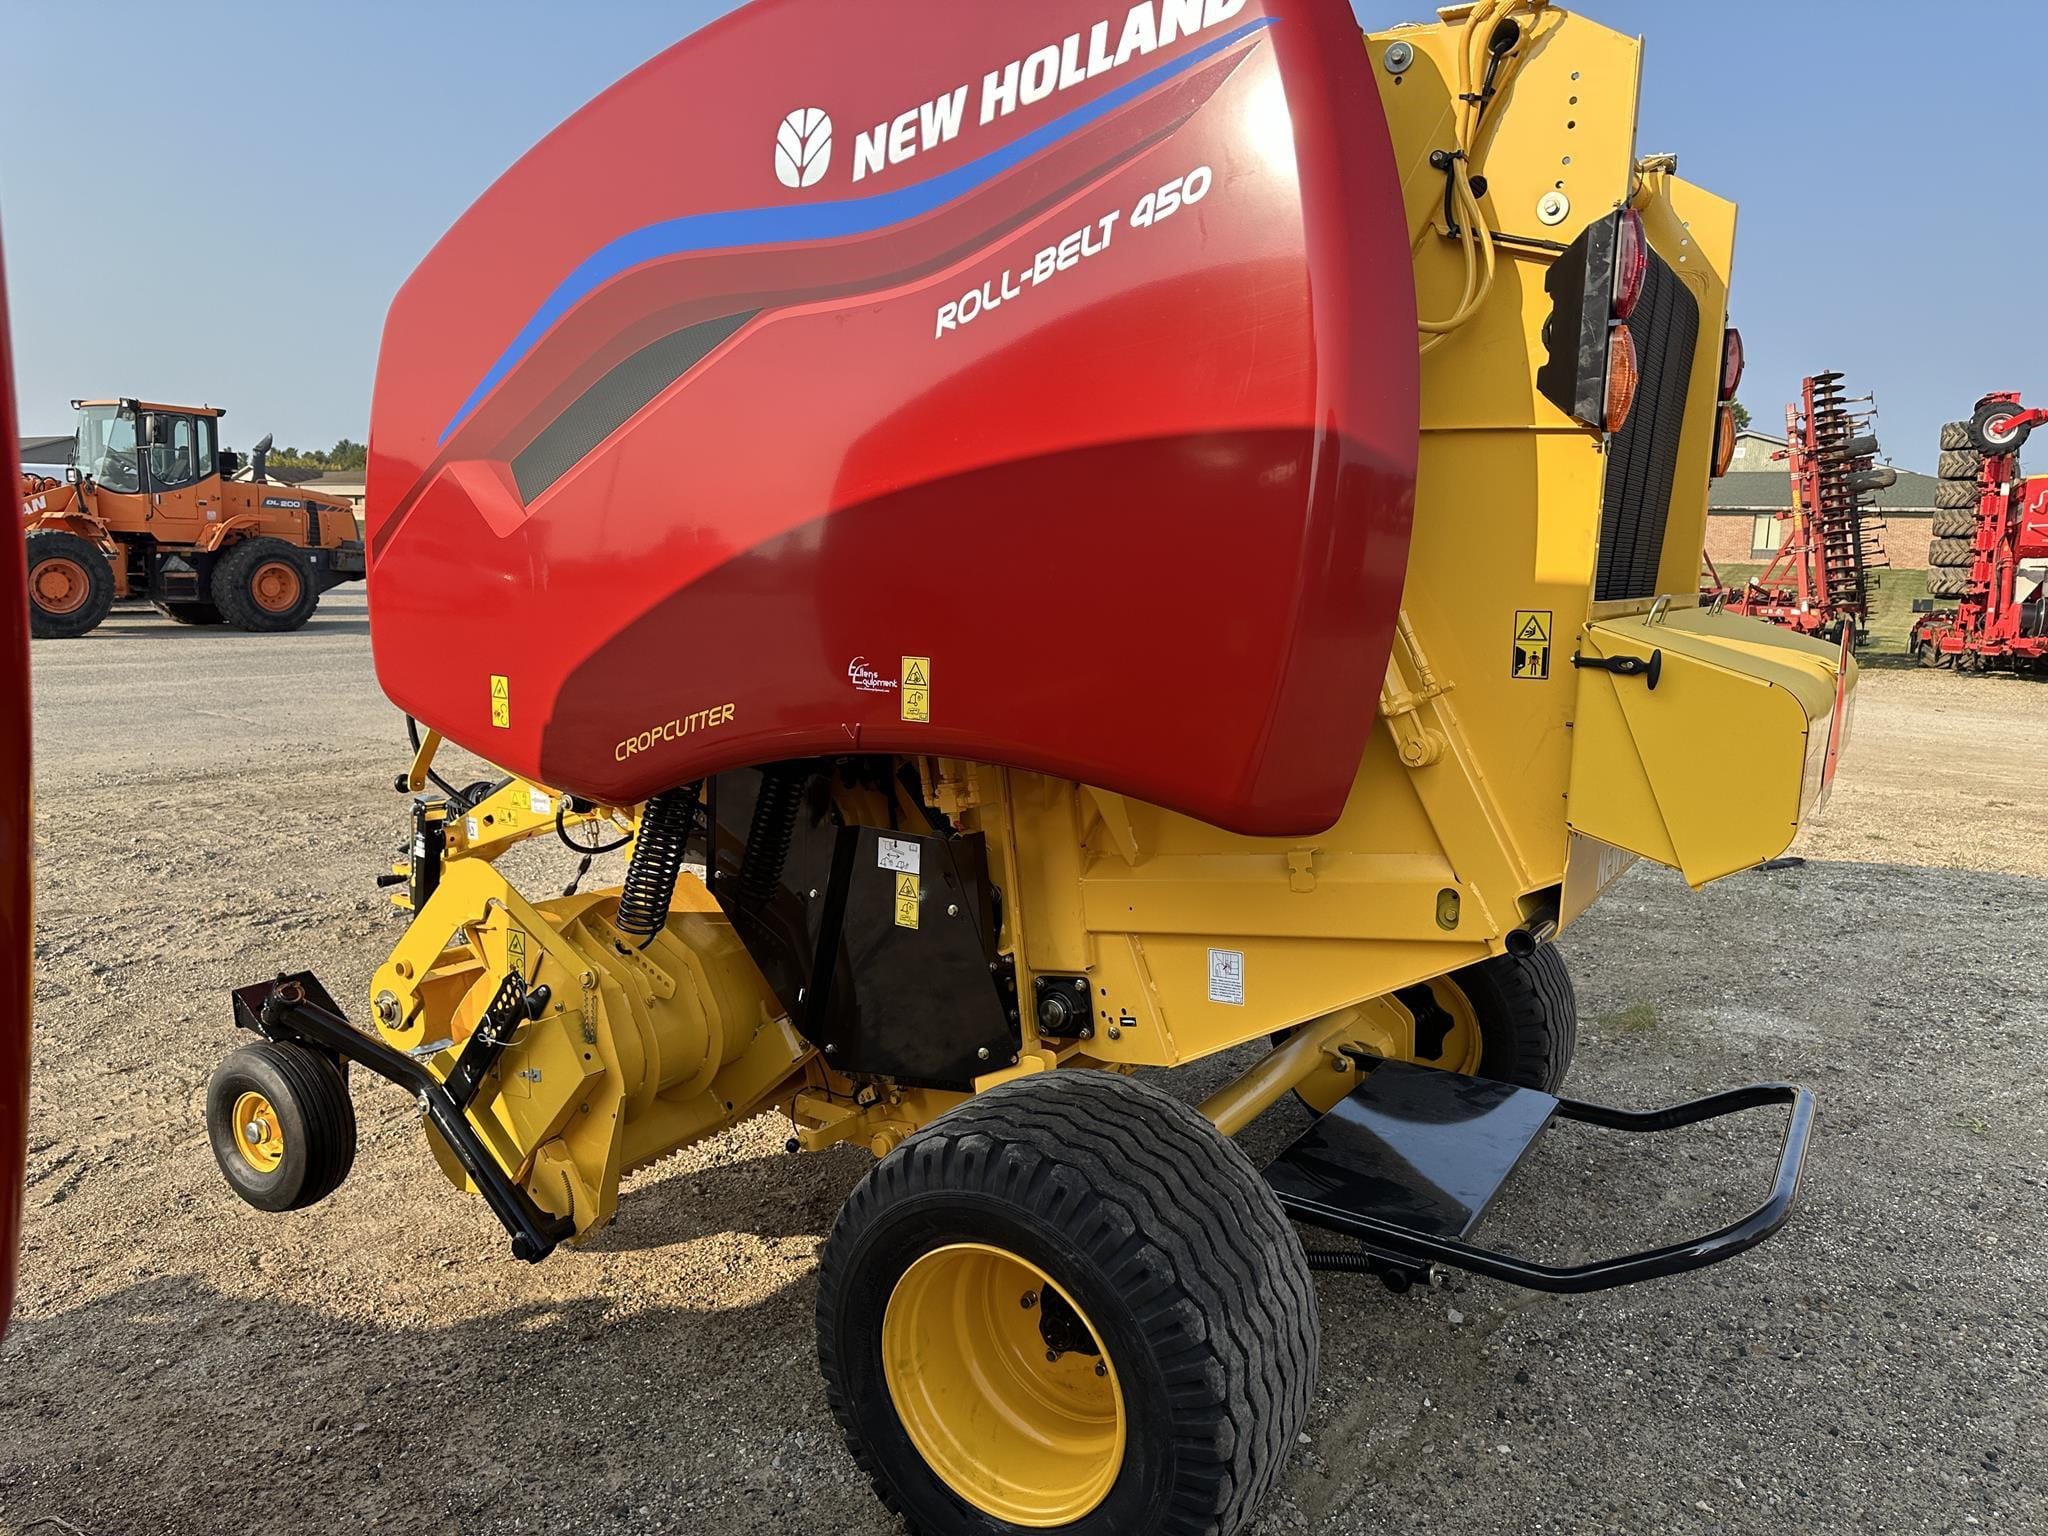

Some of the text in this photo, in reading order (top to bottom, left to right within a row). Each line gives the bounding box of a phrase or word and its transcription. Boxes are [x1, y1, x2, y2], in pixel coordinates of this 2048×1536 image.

[852, 84, 968, 183] NEW
[935, 166, 1212, 340] ROLL-BELT 450
[280, 500, 301, 508] 200
[615, 703, 735, 761] CROPCUTTER
